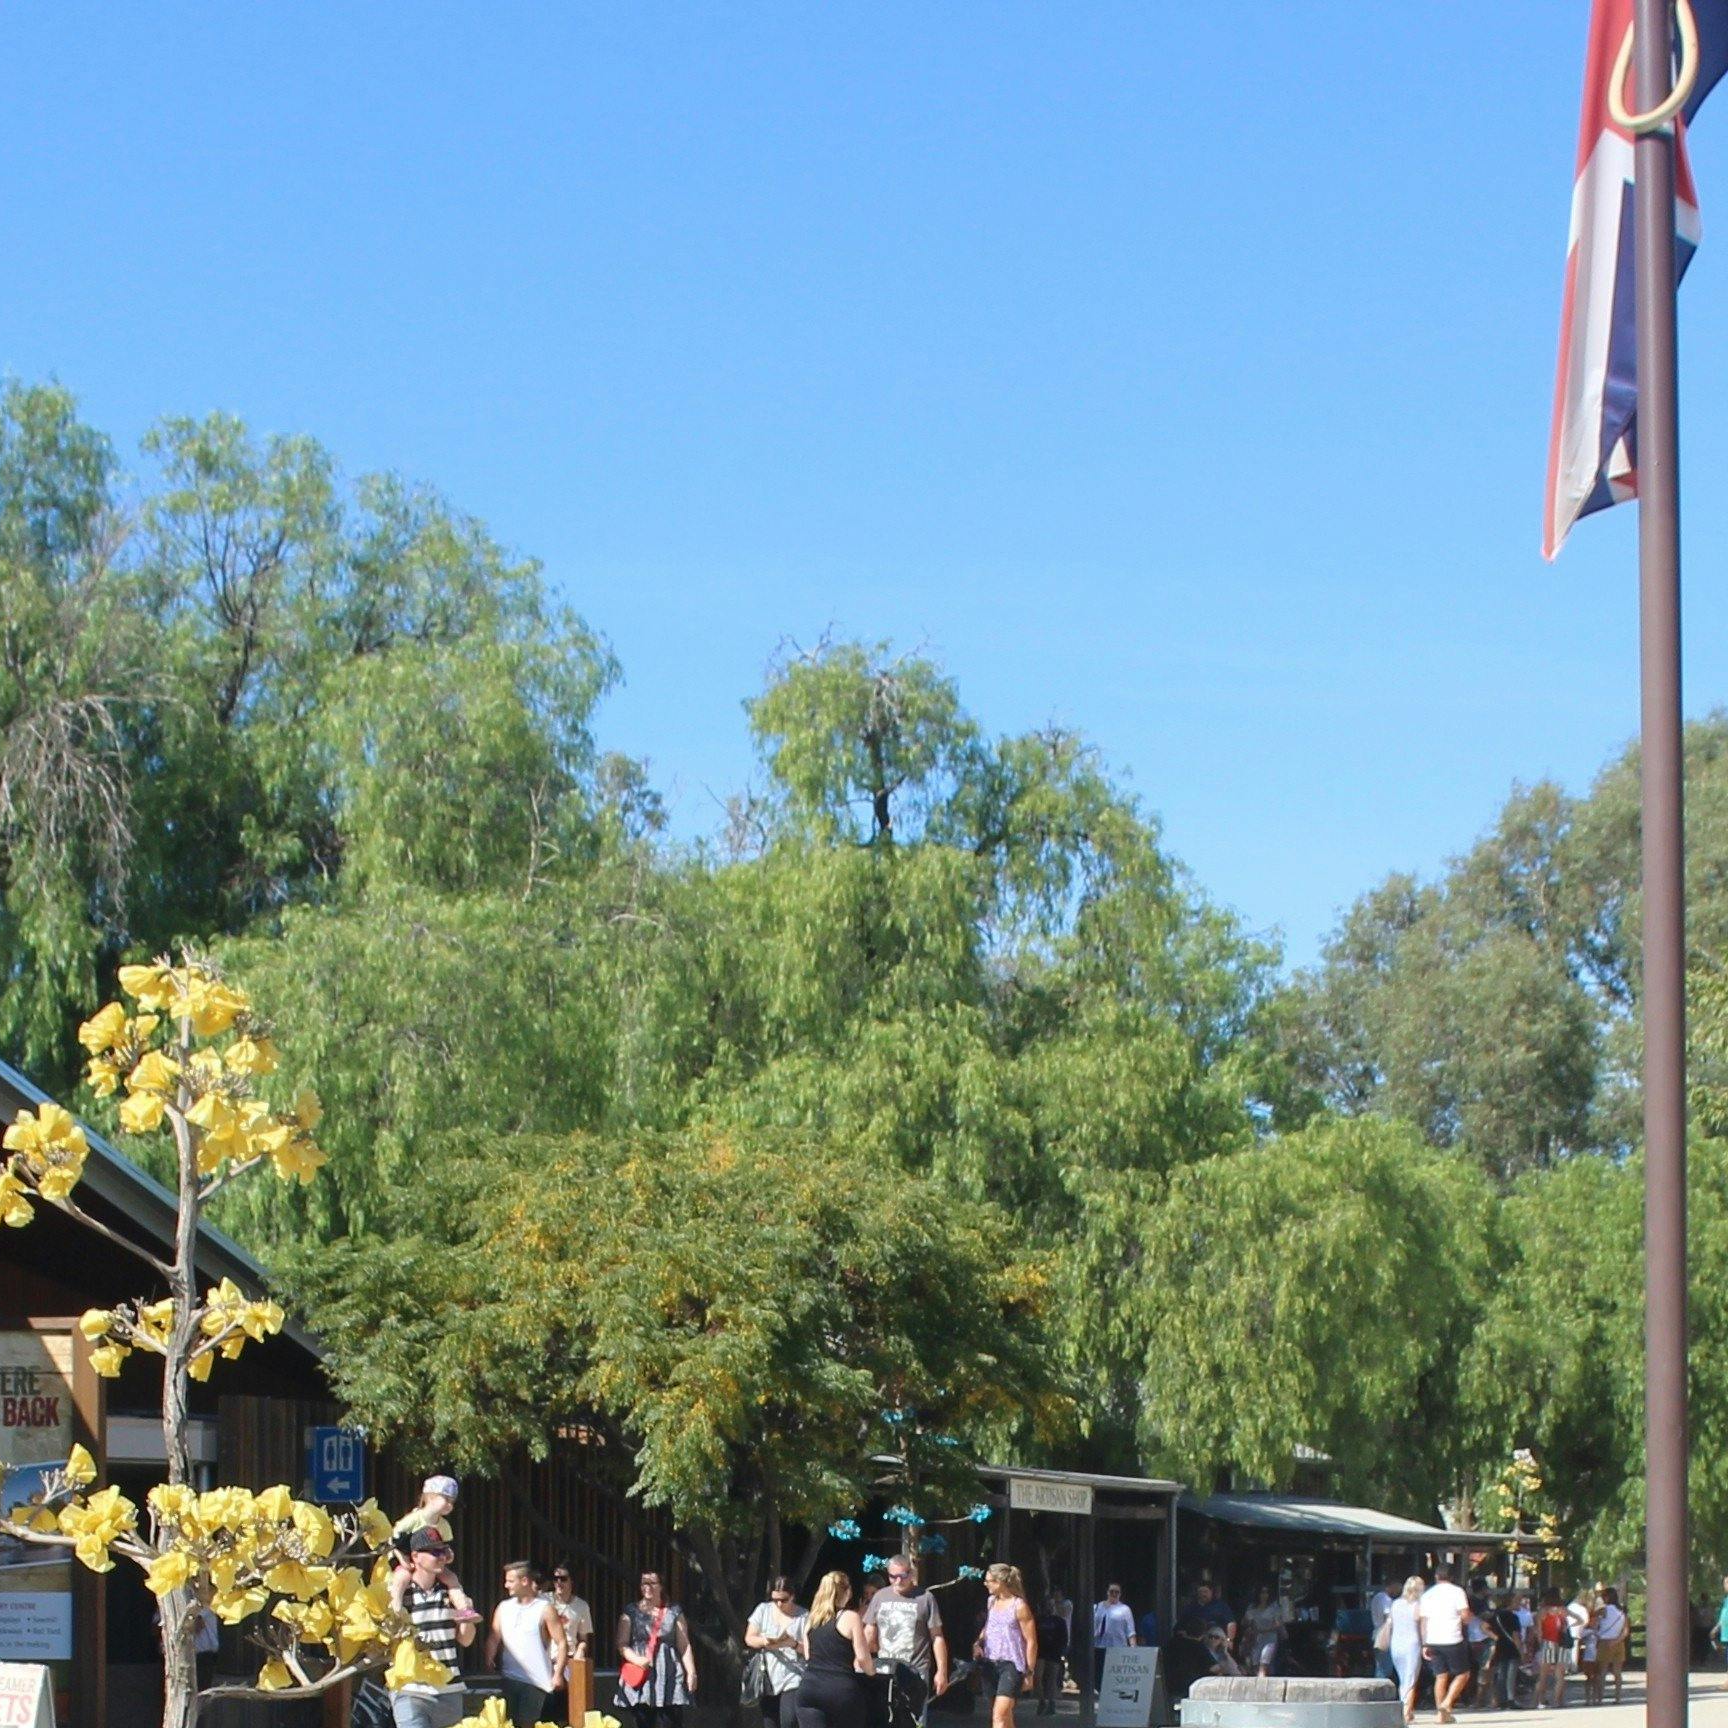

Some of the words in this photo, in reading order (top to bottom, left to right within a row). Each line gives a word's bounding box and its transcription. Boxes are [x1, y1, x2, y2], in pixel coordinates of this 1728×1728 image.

[3, 1396, 60, 1427] BACK
[1120, 1655, 1141, 1664] THE
[1107, 1664, 1149, 1674] ARTISAN
[1114, 1675, 1141, 1685] SHOP
